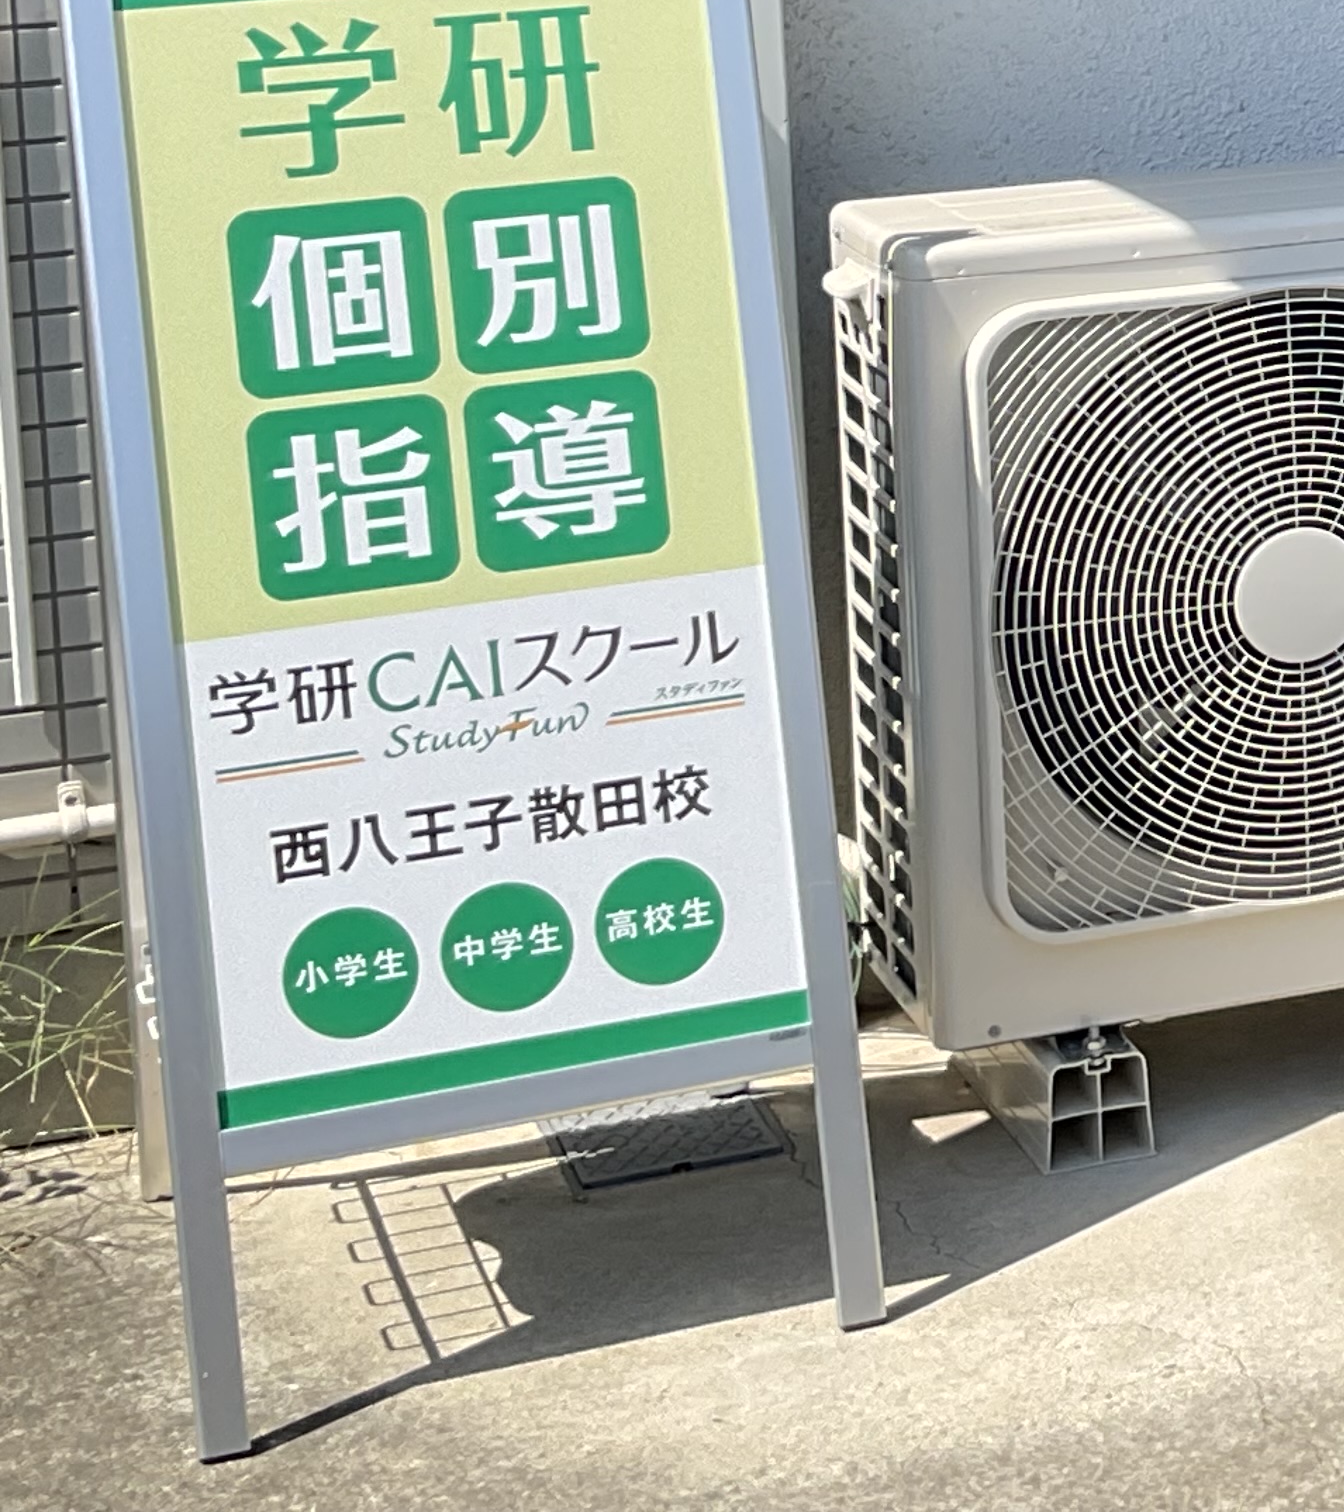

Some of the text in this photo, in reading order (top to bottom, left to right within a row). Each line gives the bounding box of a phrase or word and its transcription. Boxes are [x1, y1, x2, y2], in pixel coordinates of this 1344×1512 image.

[237, 5, 600, 179] 学研
[251, 203, 622, 370] 個別
[273, 400, 646, 573] 指導
[208, 610, 740, 735] 学研CAIスクール
[655, 677, 743, 701] スタディファン
[270, 765, 712, 884] 西八王子散田校
[295, 896, 714, 993] 小学生 中学生 高校生
